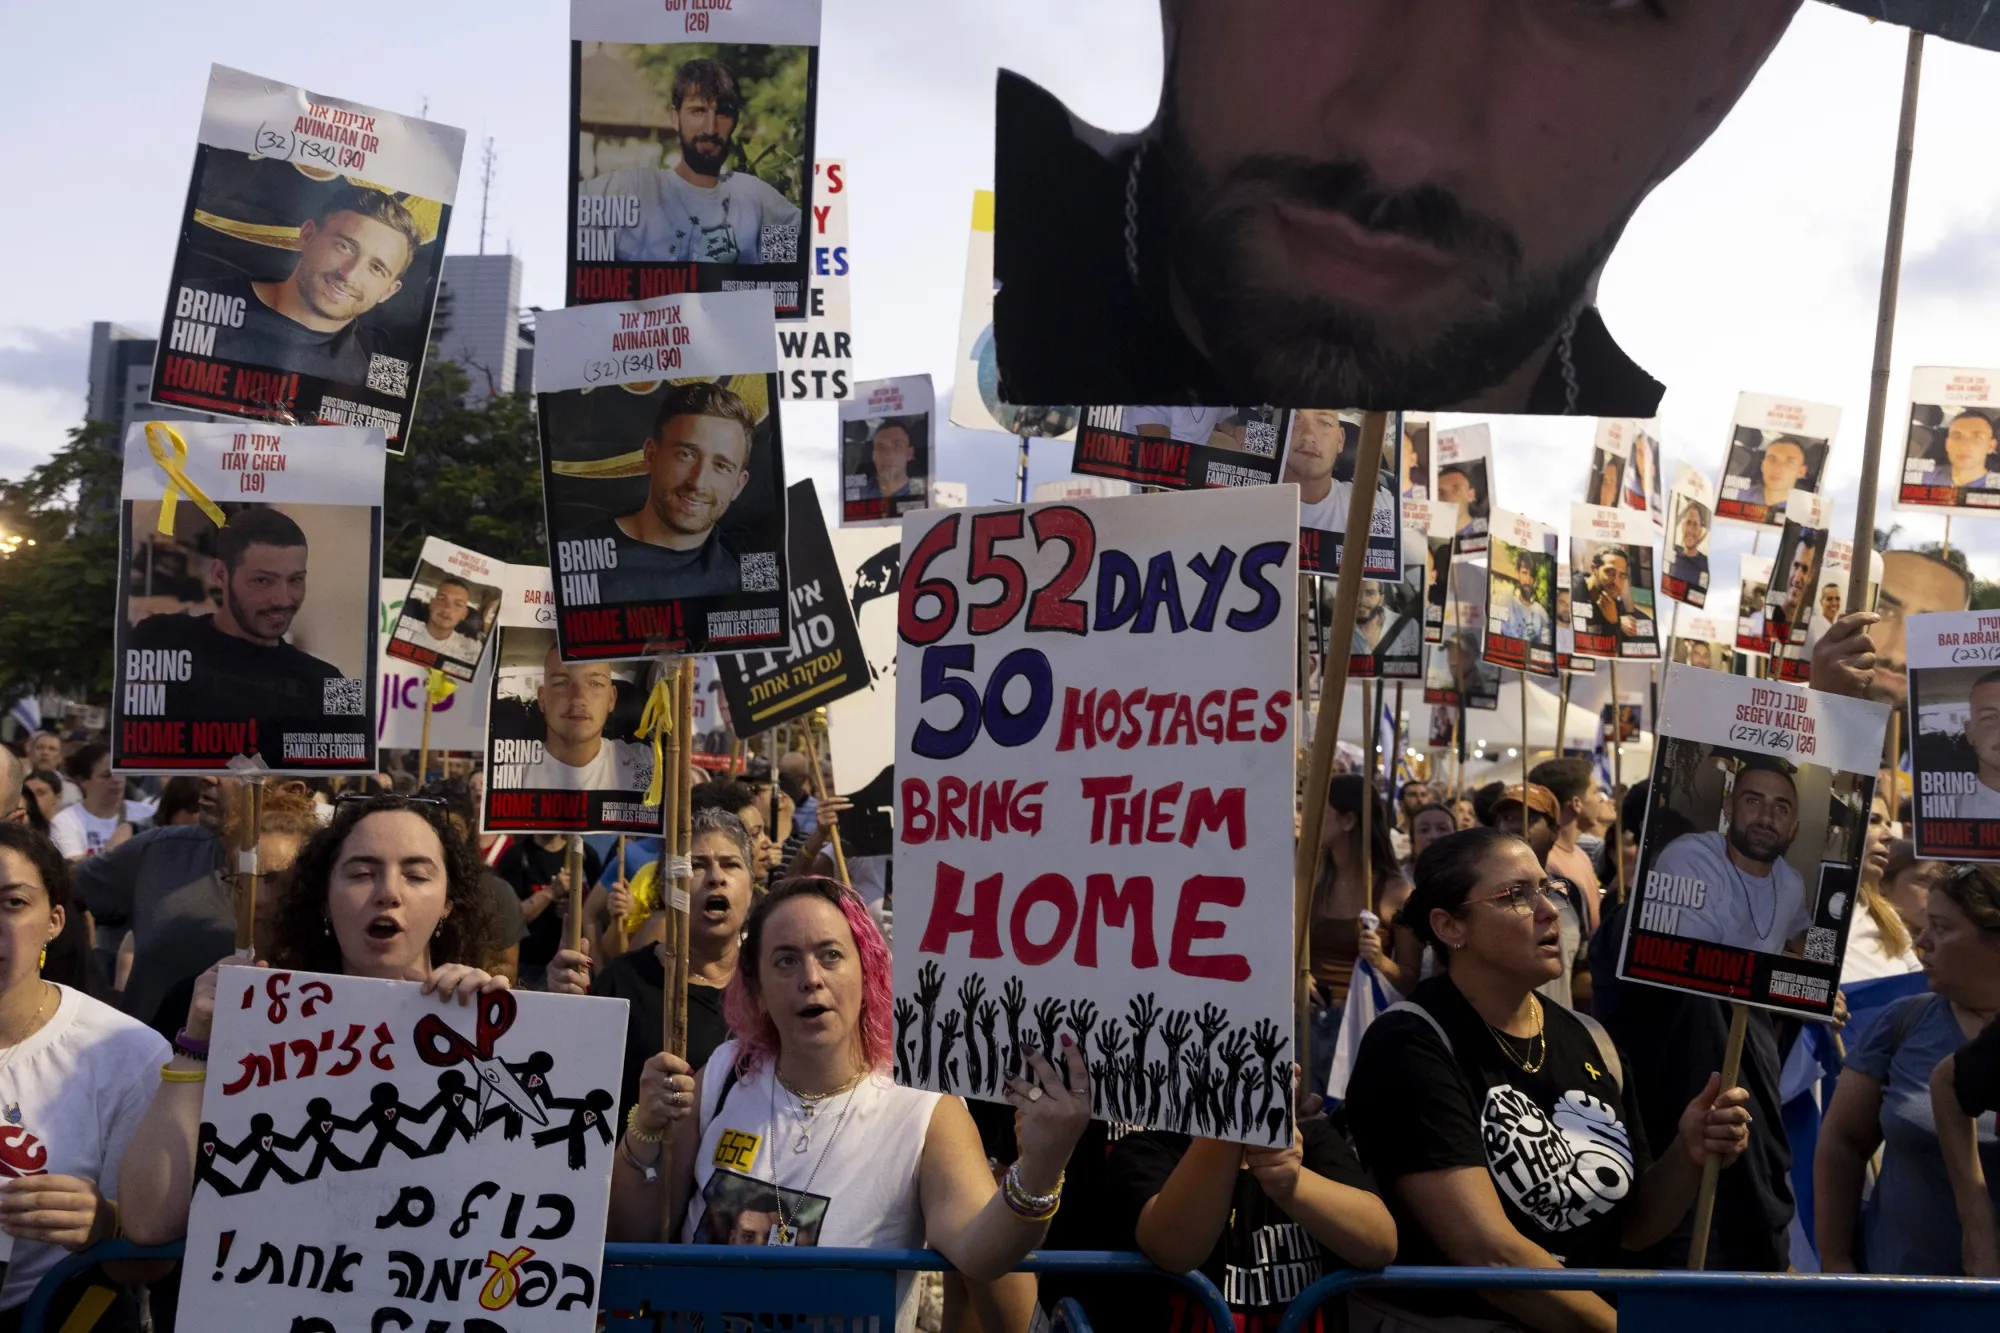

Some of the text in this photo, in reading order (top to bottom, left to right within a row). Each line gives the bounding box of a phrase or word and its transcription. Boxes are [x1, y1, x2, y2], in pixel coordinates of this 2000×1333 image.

[685, 12, 709, 33] (26)
[308, 103, 376, 132] אבינתן אור
[255, 121, 295, 160] (32)
[294, 115, 379, 154] AVINATAN OR
[578, 194, 640, 228] BRING
[577, 229, 616, 262] HIM
[576, 267, 633, 299] HOME
[722, 280, 754, 292] HOSTAGES
[770, 281, 798, 292] MISSING
[176, 286, 246, 329] BRING
[772, 292, 798, 307] ORUM
[620, 306, 681, 329] אבינתן אור
[169, 319, 217, 357] HIM
[613, 326, 690, 352] AVINATAN OR
[779, 332, 852, 358] WAR
[163, 355, 300, 409] HOME NOW!
[584, 357, 620, 382] (32)
[319, 406, 365, 428] FAMILIES
[322, 395, 402, 424] HOSTAGES AND MISSING
[1087, 406, 1123, 431] HIM
[232, 433, 281, 452] איתי חן
[1082, 431, 1192, 475] HOME NOW!
[221, 452, 286, 472] ITAY CHEN
[1207, 461, 1271, 481] HOSTAGES AND MISSING
[240, 472, 265, 493] (19)
[1206, 471, 1242, 487] FAMILIES
[557, 537, 618, 573] BRING
[1369, 557, 1395, 570] FORUM
[1372, 548, 1395, 558] MISSING
[897, 505, 1291, 647] 652 DAYS
[524, 590, 542, 605] BAR
[561, 573, 601, 607] HIM
[565, 600, 685, 643] HOME NOW!
[707, 607, 779, 623] HOSTAGES AND MISSING
[707, 618, 780, 638] FAMILIES FORUM
[1938, 632, 1960, 646] BAR
[126, 649, 192, 682] BRING
[792, 649, 842, 686] עסקה
[1951, 647, 1988, 664] (23)
[123, 683, 166, 716] HIM
[911, 644, 1291, 759] 50 HOSTAGES
[1752, 688, 1808, 713] שגב כלפון
[1736, 704, 1815, 734] SEGEV KALFON
[122, 717, 258, 754] HOME NOW!
[283, 732, 365, 744] HOSTAGES AND MISSING
[283, 743, 365, 759] FAMILIES FORUM
[494, 739, 544, 764] BRING
[492, 765, 523, 789] HIM
[1920, 771, 1977, 795] BRING
[491, 792, 588, 819] HOME NOW!
[602, 802, 627, 811] HOSTAGES
[627, 803, 638, 811] AND
[602, 809, 659, 824] FAMILIES FORUM
[900, 775, 1247, 850] BRING THEM
[1922, 795, 1957, 819] HIM
[1923, 822, 1975, 845] HOME
[1644, 870, 1706, 909] BRING
[919, 861, 1252, 982] HOME
[1639, 901, 1680, 935] HIM
[1633, 935, 1755, 986] HOME NOW!
[1769, 980, 1829, 1003] FAMILIES FORUM
[1772, 970, 1830, 989] HOSTAGES AND MISSING
[241, 973, 333, 1025] בלי
[223, 1022, 395, 1096] גזירות
[715, 1132, 757, 1167] 652
[1494, 1129, 1571, 1194] THEM
[375, 1181, 575, 1240] כולם
[211, 1230, 364, 1294] אחת!
